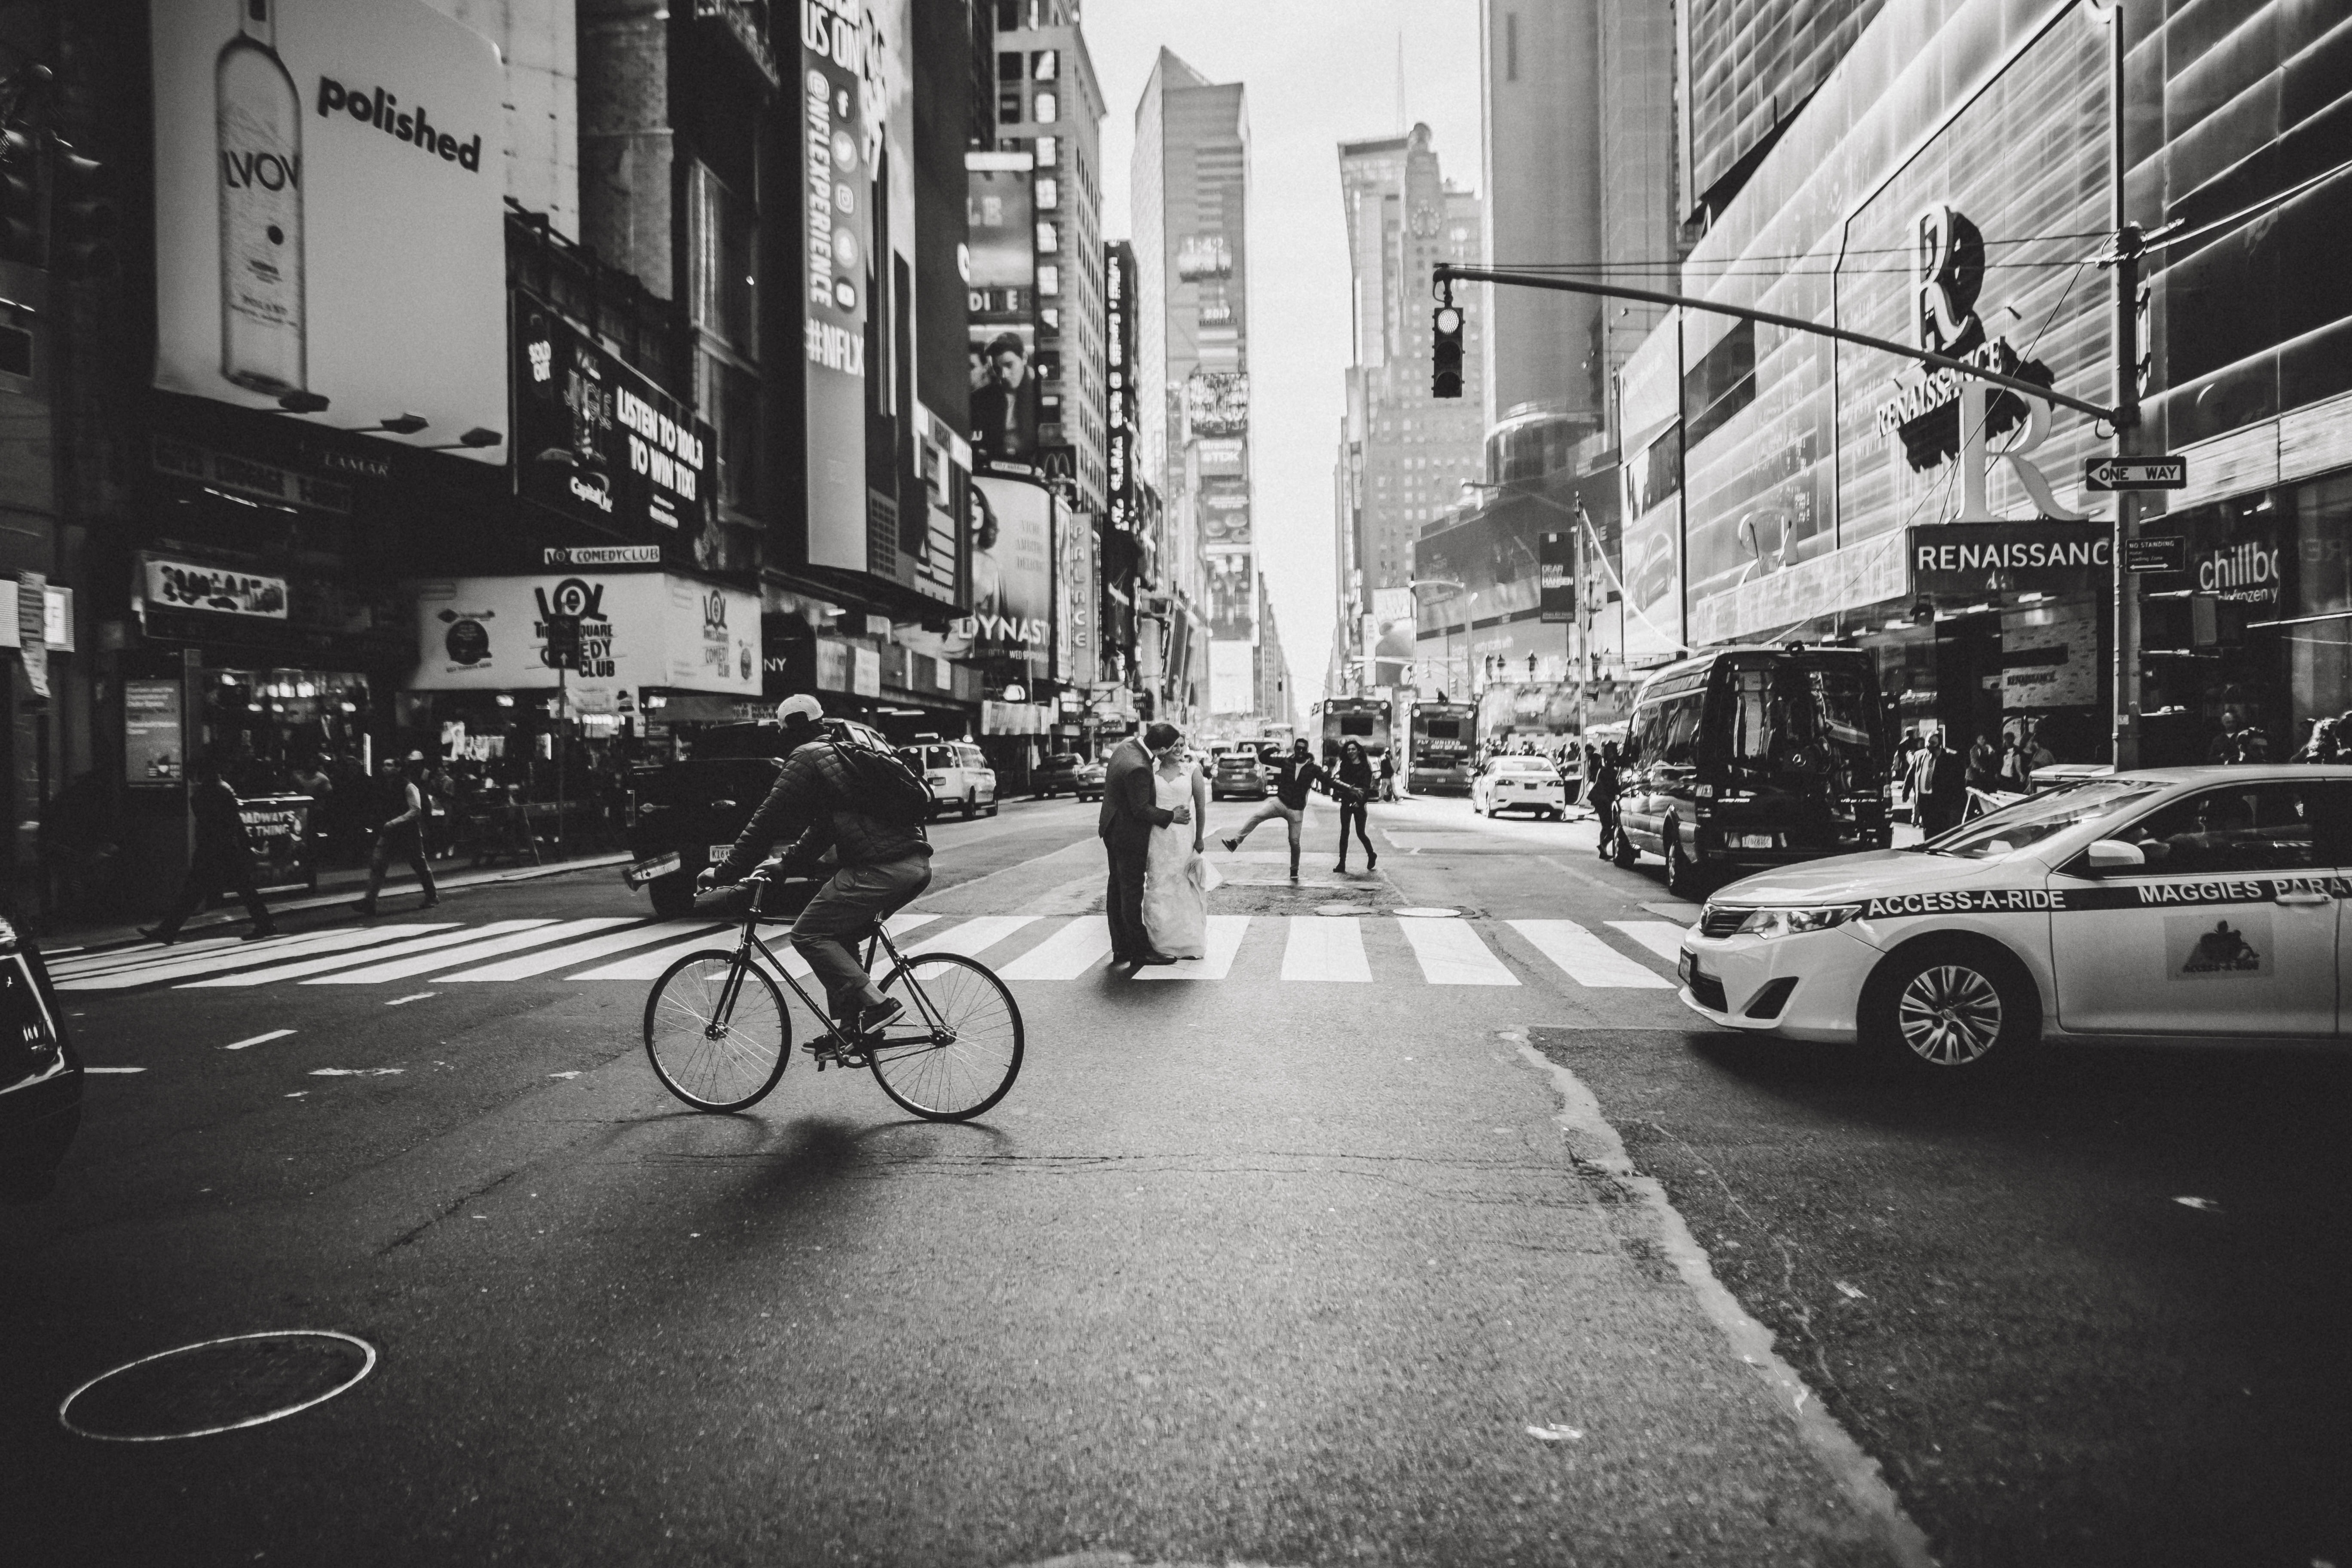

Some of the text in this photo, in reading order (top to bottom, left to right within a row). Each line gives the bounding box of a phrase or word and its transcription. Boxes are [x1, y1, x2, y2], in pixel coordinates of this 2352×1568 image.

[318, 76, 481, 173] polished
[222, 151, 300, 191] LVOV
[617, 386, 658, 443] LISTEN
[659, 413, 676, 452] TO
[628, 434, 648, 475] TO
[649, 447, 674, 490] WIN
[2099, 466, 2177, 481] ONE WAY
[1918, 542, 2110, 570] RENAISSANC
[1542, 577, 1574, 586] HANSEN
[580, 624, 612, 638] QUARE
[959, 613, 1051, 645] DYNASTY
[541, 639, 612, 665] CEDY
[764, 658, 786, 671] NY
[1009, 649, 1022, 660] WED
[579, 660, 615, 678] CLUB
[1868, 890, 2067, 916] ACCESS-A-RIDE
[2138, 879, 2263, 903] MAGGIES
